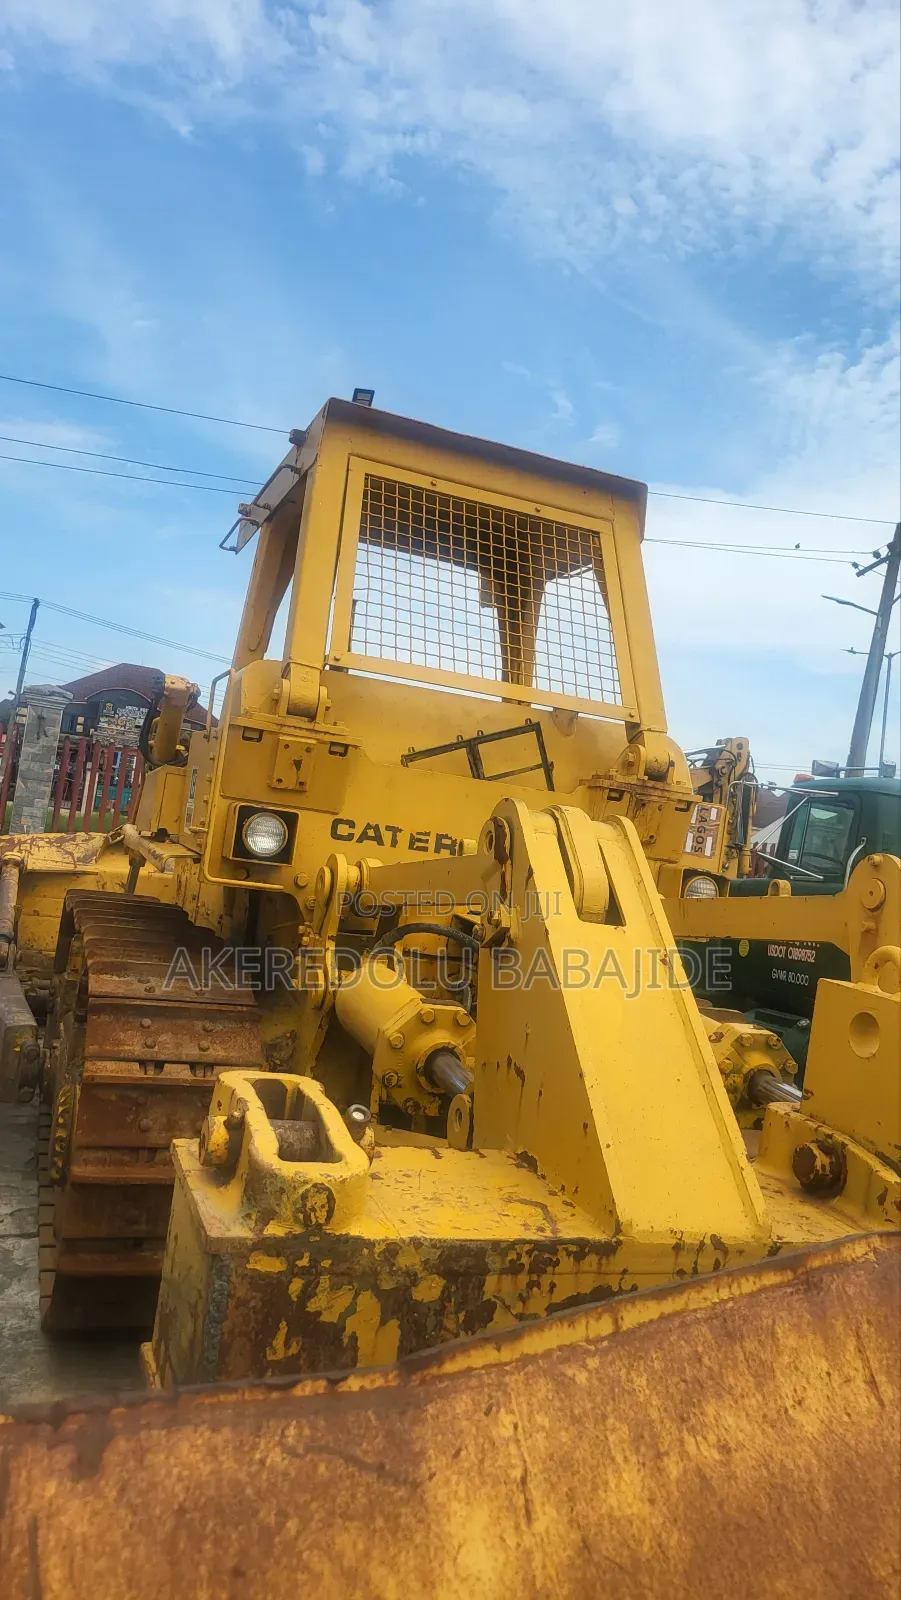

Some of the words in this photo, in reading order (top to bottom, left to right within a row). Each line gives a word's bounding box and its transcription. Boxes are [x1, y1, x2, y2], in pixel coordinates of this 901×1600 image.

[694, 807, 709, 853] LAGOS
[767, 943, 787, 958] USDOT
[771, 968, 787, 982] GVWR
[787, 971, 810, 986] 80,000
